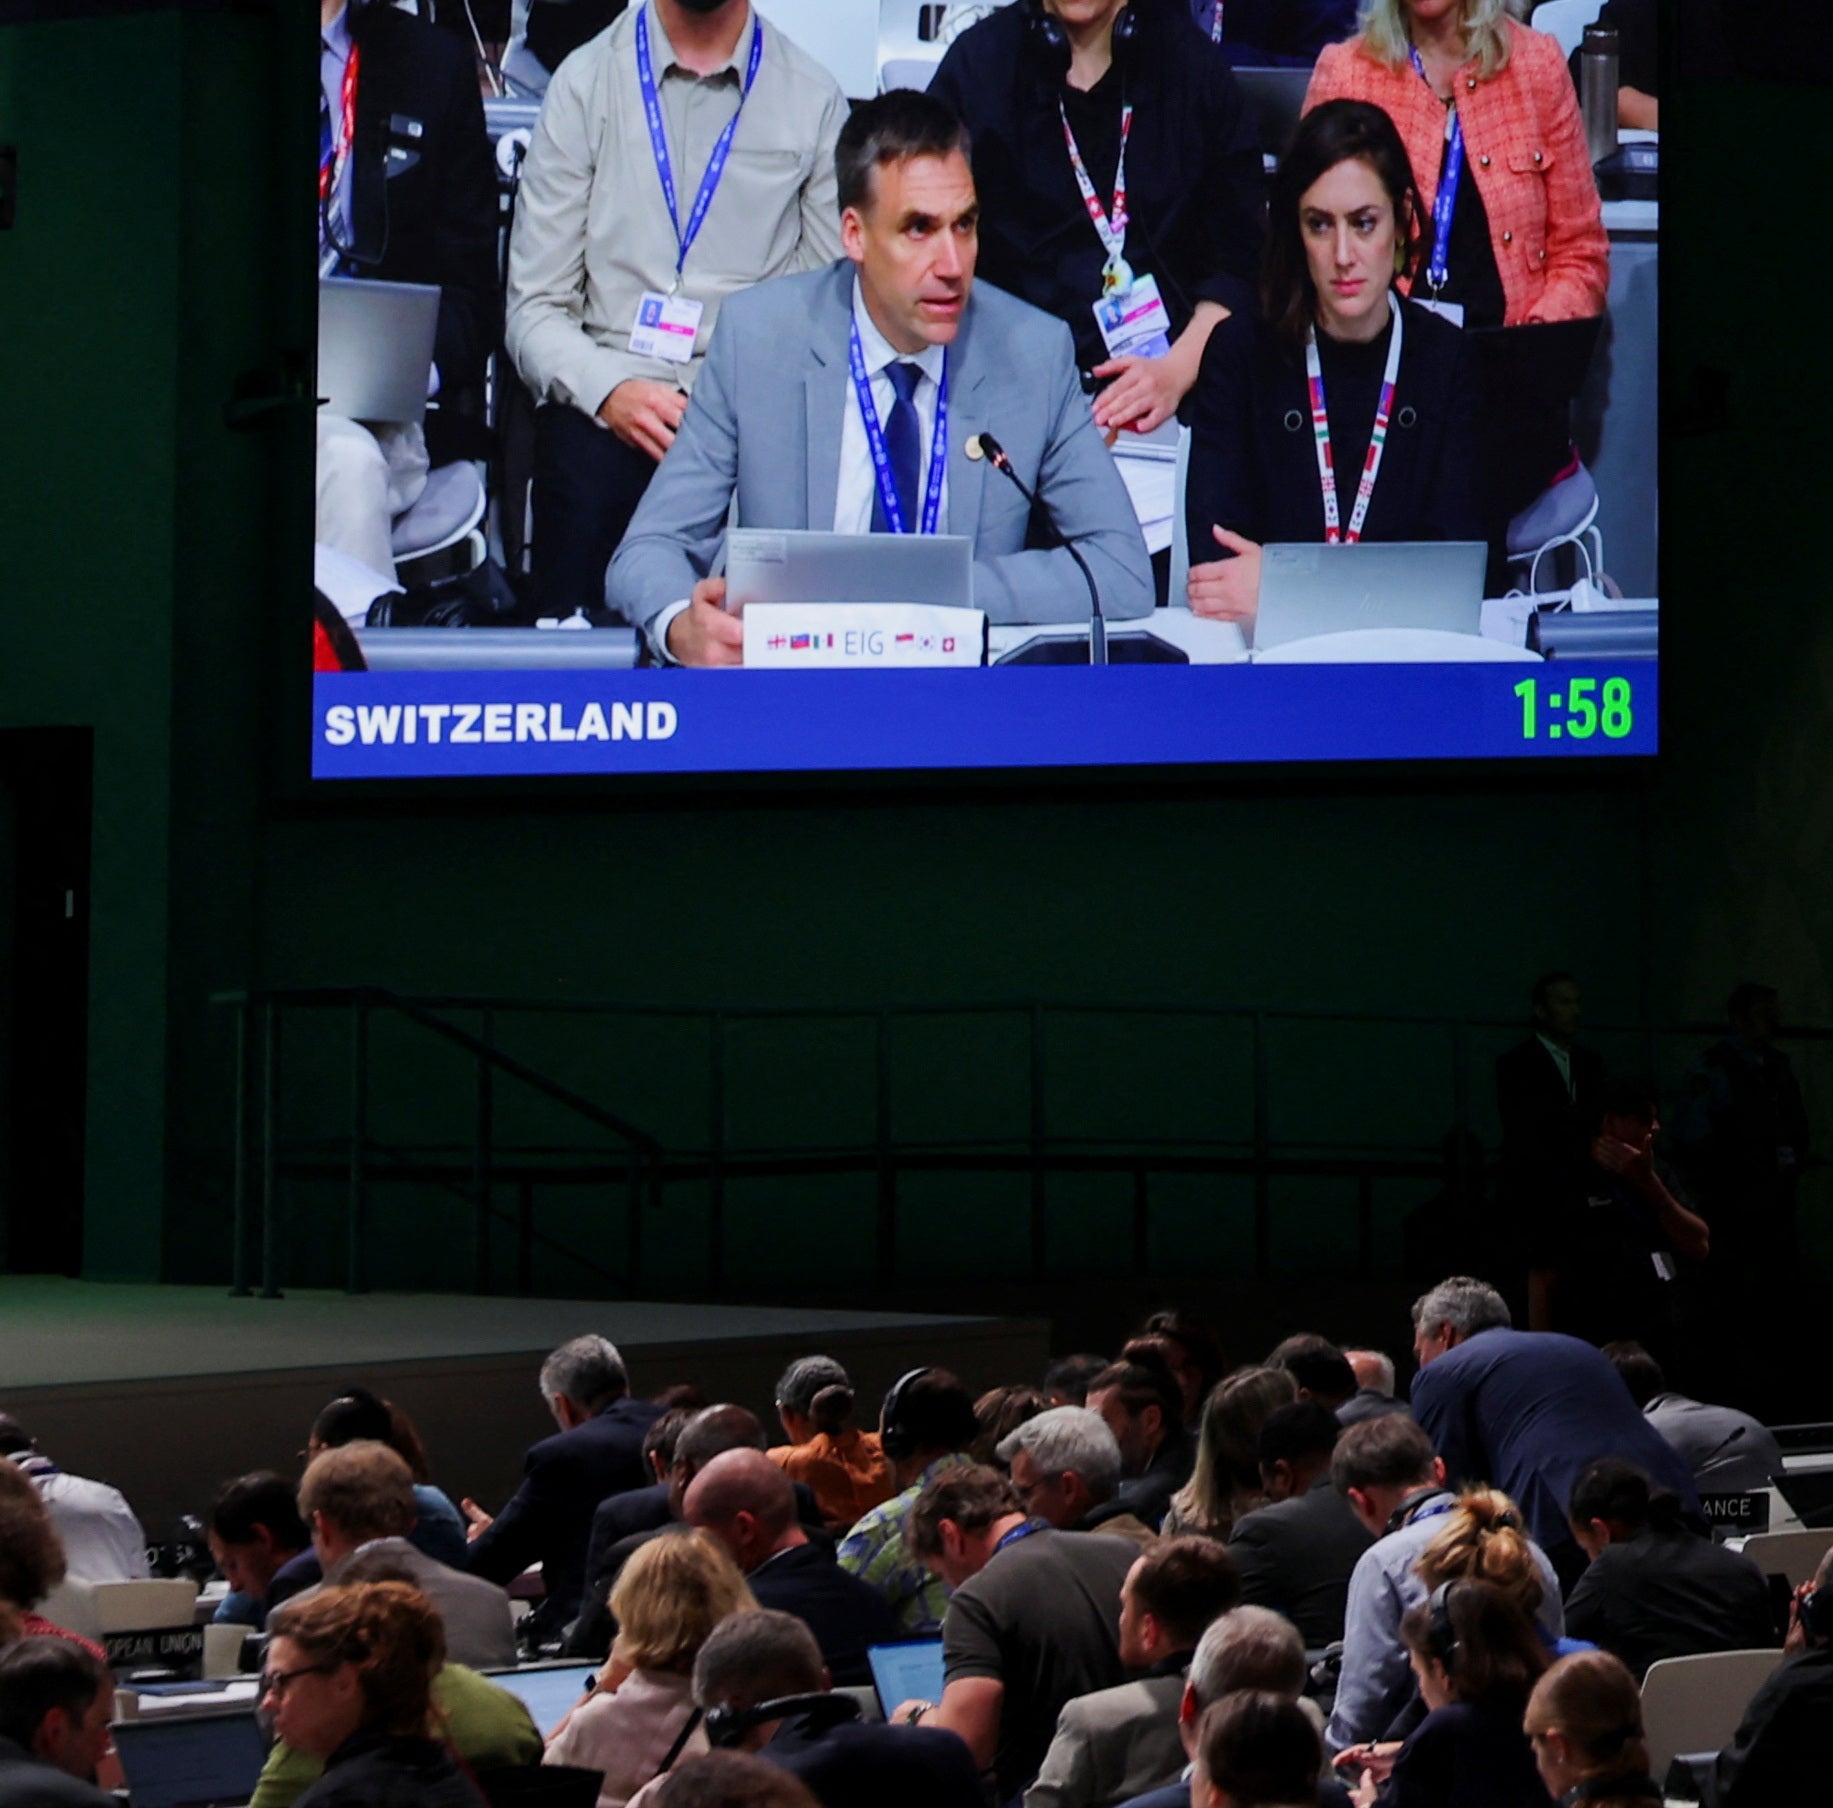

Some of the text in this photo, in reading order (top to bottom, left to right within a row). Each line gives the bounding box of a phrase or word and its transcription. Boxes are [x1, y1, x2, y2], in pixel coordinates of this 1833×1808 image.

[844, 630, 884, 656] EIG
[1514, 676, 1633, 740] 1:58
[324, 701, 678, 747] SWITZERLAND
[1703, 1497, 1752, 1518] ANCE
[106, 1633, 203, 1658] OPEAN UNION
